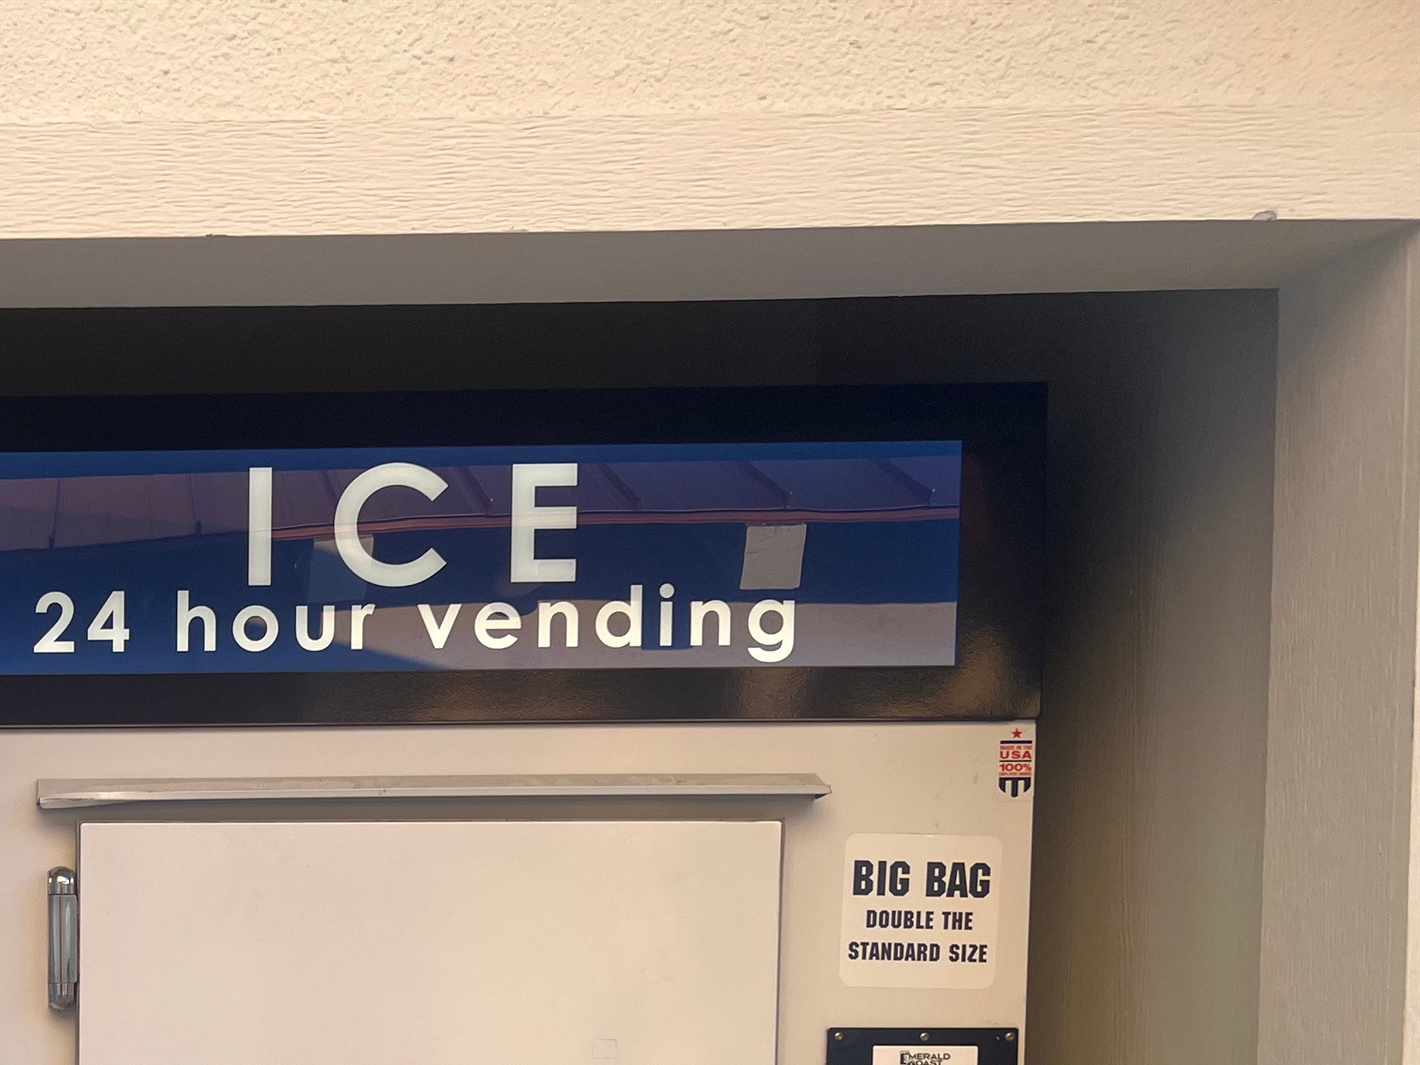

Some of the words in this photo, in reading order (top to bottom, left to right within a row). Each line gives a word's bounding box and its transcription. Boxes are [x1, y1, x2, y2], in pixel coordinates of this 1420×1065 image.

[247, 463, 579, 588] ICE
[33, 590, 131, 654] 24
[176, 591, 376, 652] hour
[417, 583, 797, 663] vending
[1000, 751, 1032, 759] USA
[999, 763, 1032, 772] 100%
[852, 860, 911, 897] BIG
[925, 861, 991, 898] BAG
[866, 909, 934, 929] DOUBLE
[942, 911, 974, 930] THE
[848, 942, 941, 962] STANDARD
[949, 943, 988, 963] SIZE
[900, 1051, 951, 1065] EMERALD
